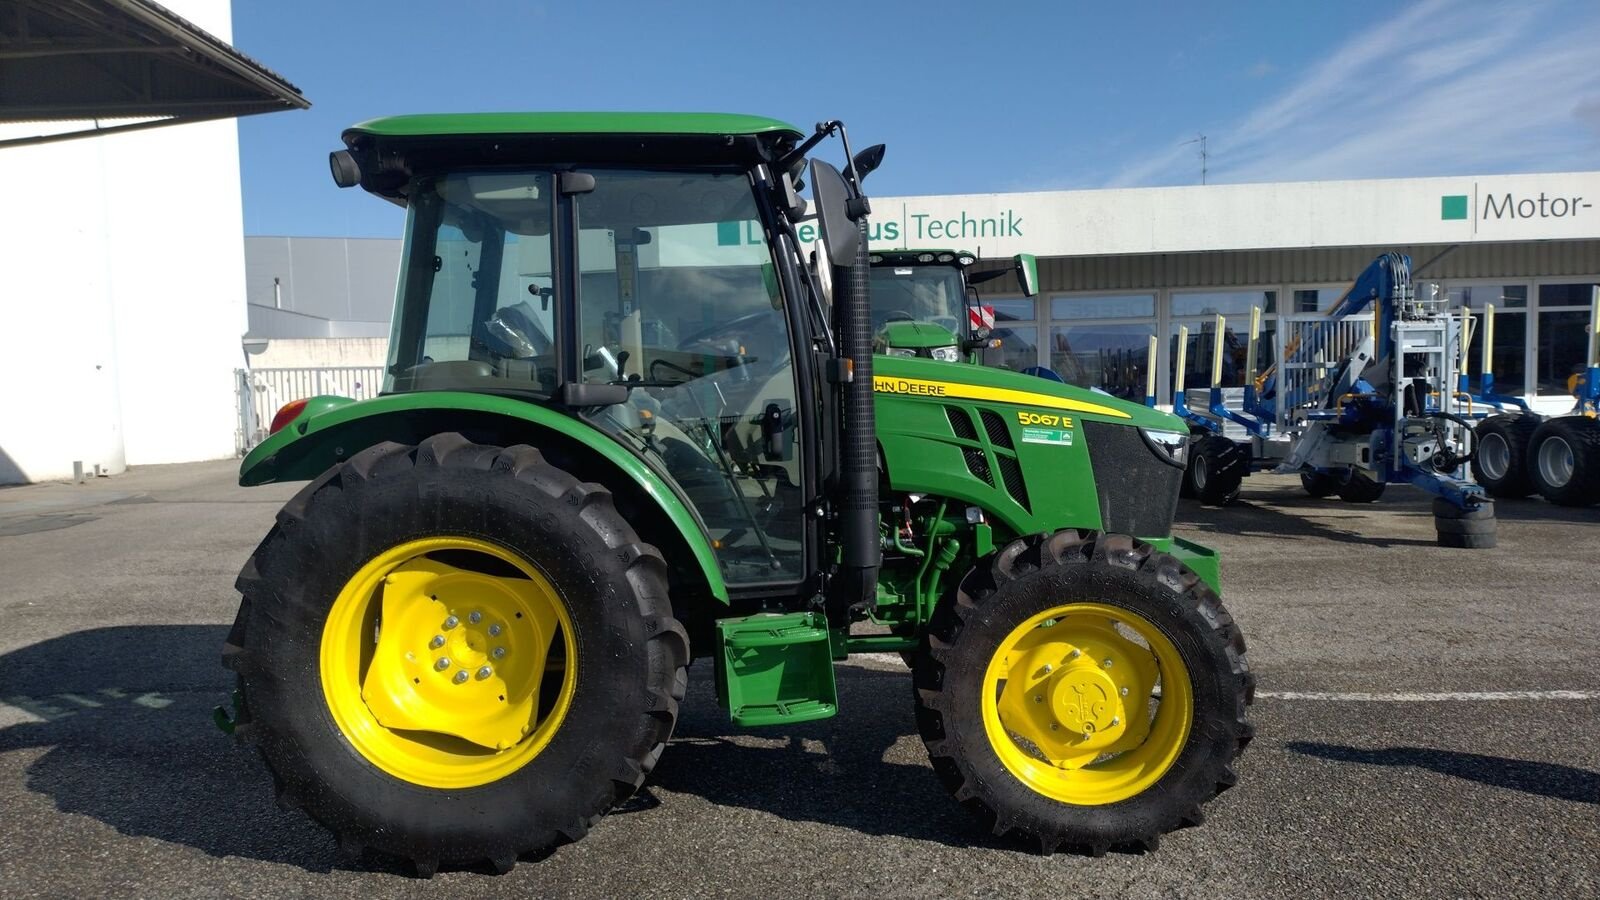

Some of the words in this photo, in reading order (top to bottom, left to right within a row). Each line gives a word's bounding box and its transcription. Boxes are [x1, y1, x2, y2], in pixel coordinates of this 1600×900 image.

[1483, 192, 1592, 220] Motor-
[910, 209, 1023, 240] Technik
[874, 380, 895, 391] HN
[898, 381, 946, 395] DEERE
[1017, 411, 1060, 426] 5067
[1061, 416, 1074, 428] E
